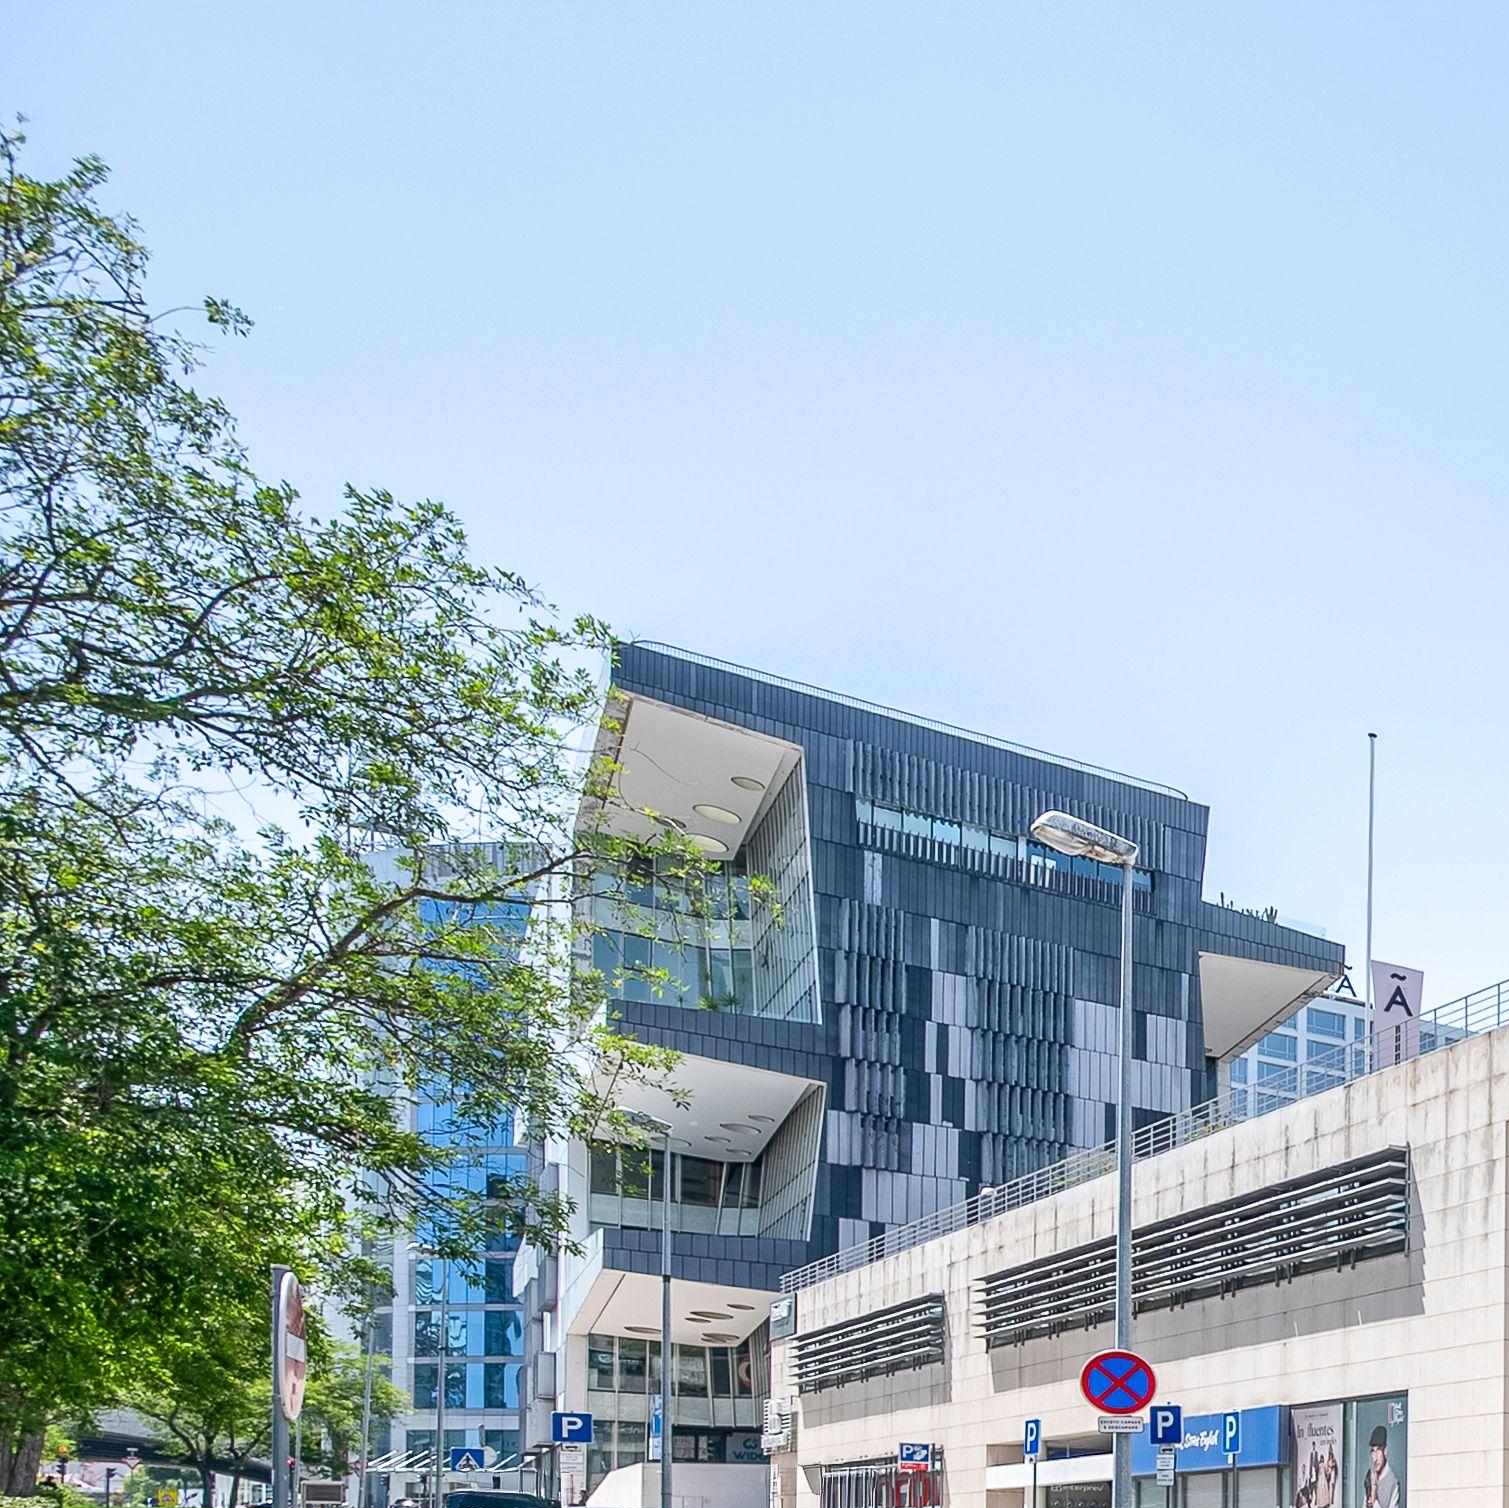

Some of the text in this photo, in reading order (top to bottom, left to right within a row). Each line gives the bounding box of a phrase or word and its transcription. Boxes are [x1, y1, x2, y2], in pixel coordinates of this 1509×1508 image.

[562, 1416, 584, 1439] P
[1026, 1422, 1037, 1452] P
[1157, 1410, 1175, 1439] P
[1225, 1415, 1237, 1450] P
[902, 1444, 914, 1459] P
